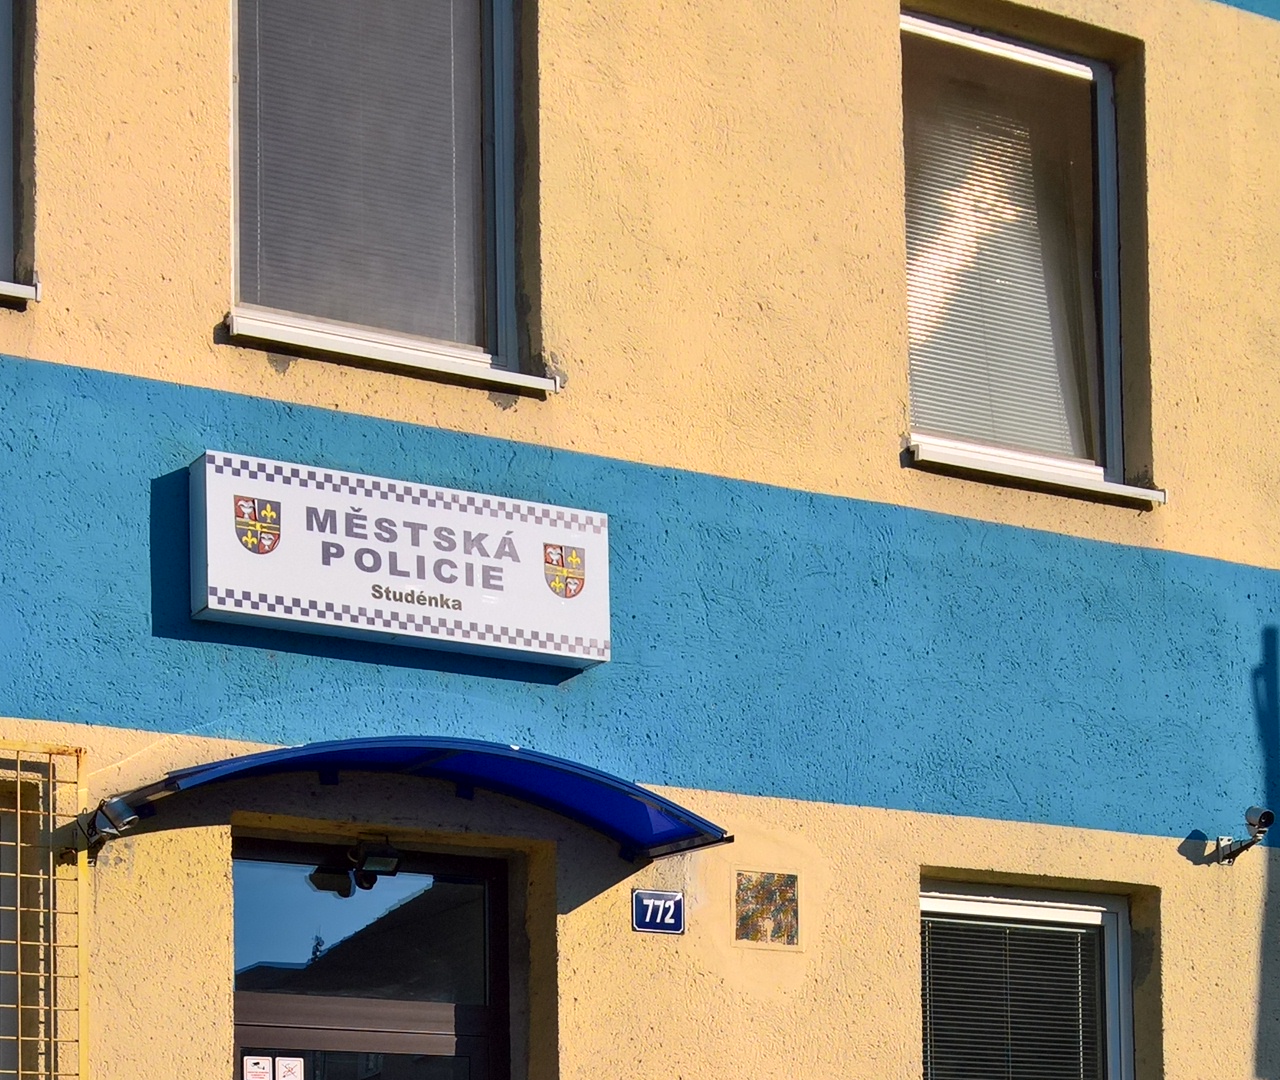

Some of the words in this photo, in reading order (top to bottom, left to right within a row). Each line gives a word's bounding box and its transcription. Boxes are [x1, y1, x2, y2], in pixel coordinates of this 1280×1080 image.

[306, 506, 521, 563] MĚSTSKÁ
[321, 540, 505, 591] POLICIE
[371, 584, 462, 611] Studénka
[642, 898, 676, 924] 772
